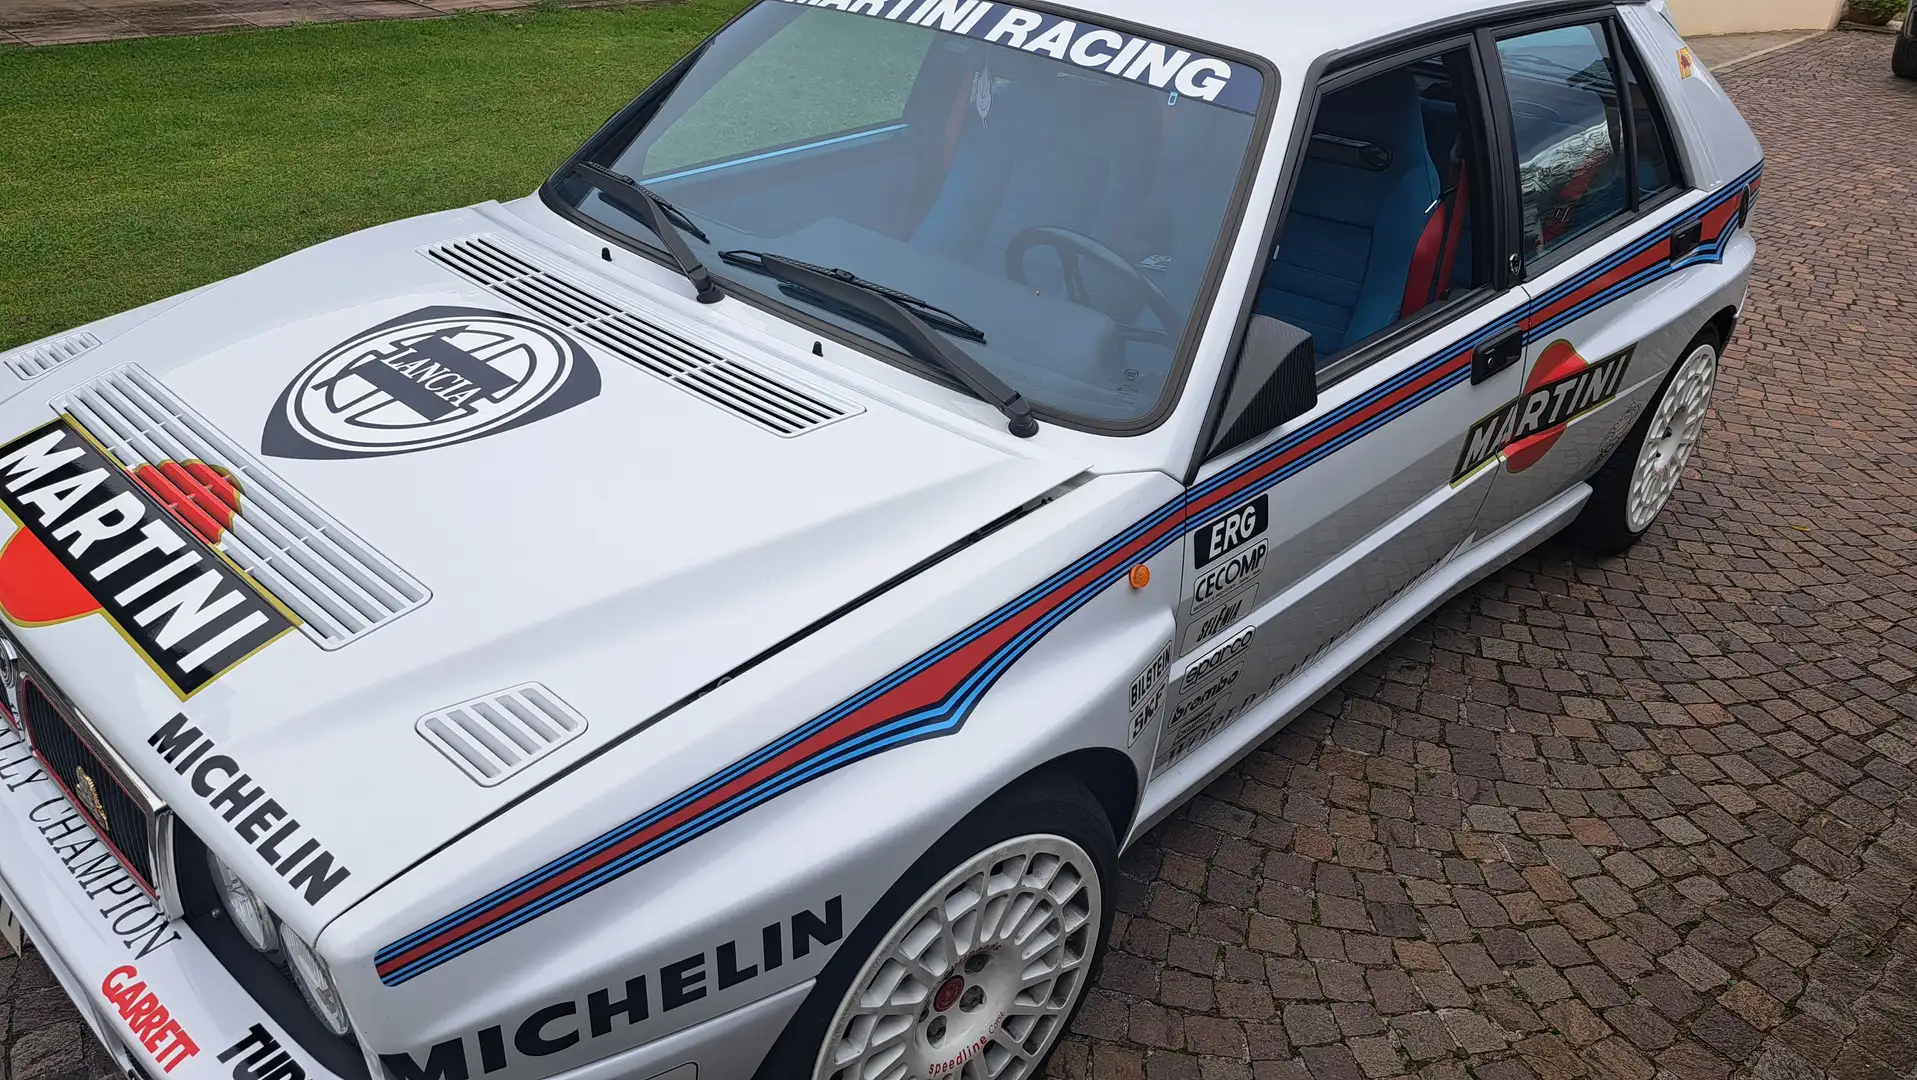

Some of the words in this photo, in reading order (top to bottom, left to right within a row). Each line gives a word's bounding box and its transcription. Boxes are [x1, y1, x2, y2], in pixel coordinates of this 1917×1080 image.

[984, 8, 1232, 102] RACING
[380, 348, 482, 407] LANCIA
[1461, 354, 1627, 472] MARTINI
[0, 429, 270, 674] MARTINI
[1208, 505, 1256, 560] ERG
[1195, 544, 1266, 602] CECOMP
[1131, 645, 1171, 701] BILSTEIN
[1185, 630, 1253, 684] sparco
[1132, 682, 1166, 740] SKF
[1172, 668, 1240, 725] brembo
[147, 711, 351, 906] MICHELIN
[29, 796, 183, 960] CHAMPION
[101, 965, 201, 1074] GARRETT
[379, 894, 843, 1080] MICHELIN
[928, 1034, 988, 1075] speedline
[988, 1010, 1006, 1034] Corse
